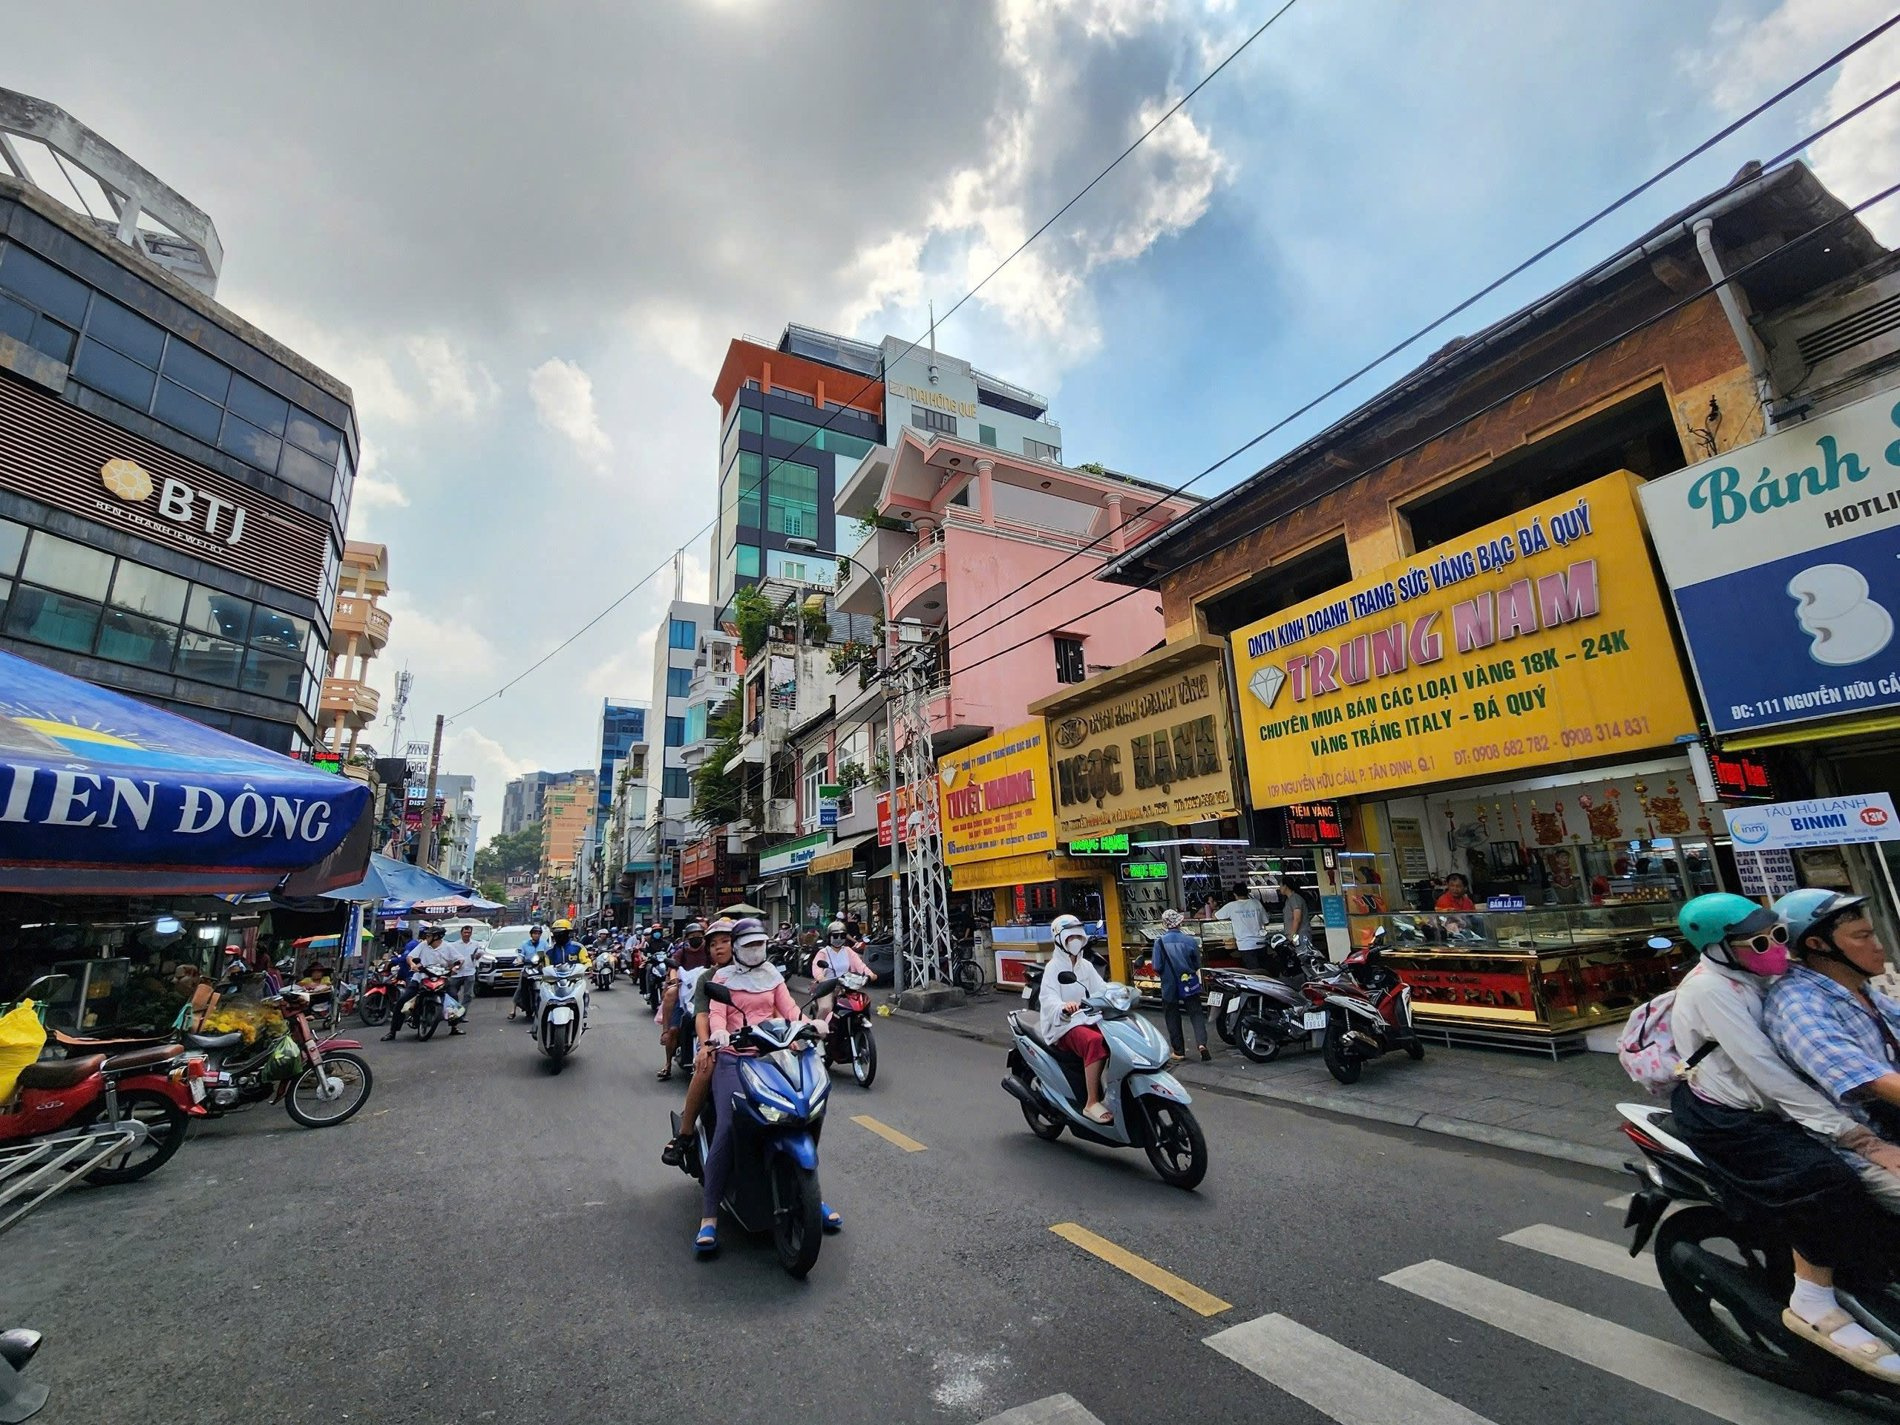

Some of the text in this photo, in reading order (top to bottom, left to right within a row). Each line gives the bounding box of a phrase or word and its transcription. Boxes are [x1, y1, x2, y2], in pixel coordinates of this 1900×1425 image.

[158, 477, 246, 545] BTJ
[1688, 435, 1870, 529] Bánh
[1824, 490, 1900, 528] HOTLI
[1248, 497, 1593, 658] DNTN KINH DOANH TRANG SỨC VÀNG BẠC ĐÁ QUÝ
[1284, 559, 1600, 703] TRUNG NAM
[1260, 711, 1310, 742] CHUYÊN
[1311, 706, 1342, 730] MUA
[1347, 694, 1377, 720] BÁN
[1381, 685, 1414, 714] CÁC
[1418, 676, 1458, 705] LOẠI
[1462, 659, 1515, 693] VÀNG
[1523, 652, 1558, 676] 18K
[1581, 629, 1629, 662] 24K
[1731, 705, 1755, 720] ĐC:
[1756, 698, 1780, 716] 111
[1782, 684, 1843, 712] NGUYỄN
[1311, 728, 1348, 757] VÀNG
[1351, 714, 1403, 749] TRẮNG
[1406, 708, 1453, 736] ITALY
[1473, 695, 1501, 720] ĐÁ
[1507, 685, 1546, 719] QUÝ
[1057, 744, 1124, 809] NGỌC
[1267, 785, 1280, 798] 109
[1368, 762, 1388, 780] TÂN
[1472, 743, 1500, 763] 0908
[1503, 738, 1525, 757] 682
[1526, 734, 1549, 753] 782
[1561, 727, 1593, 748] 0908
[1596, 721, 1621, 741] 314
[1624, 715, 1650, 737] 831
[173, 782, 331, 842] ĐÔNG
[1289, 820, 1318, 843] Trung
[1290, 803, 1334, 819] TIỆM VÀNG
[1764, 805, 1792, 818] TÀU
[1823, 798, 1868, 814] LẠNH
[1791, 812, 1847, 831] BINMI
[1862, 811, 1888, 823] 13K
